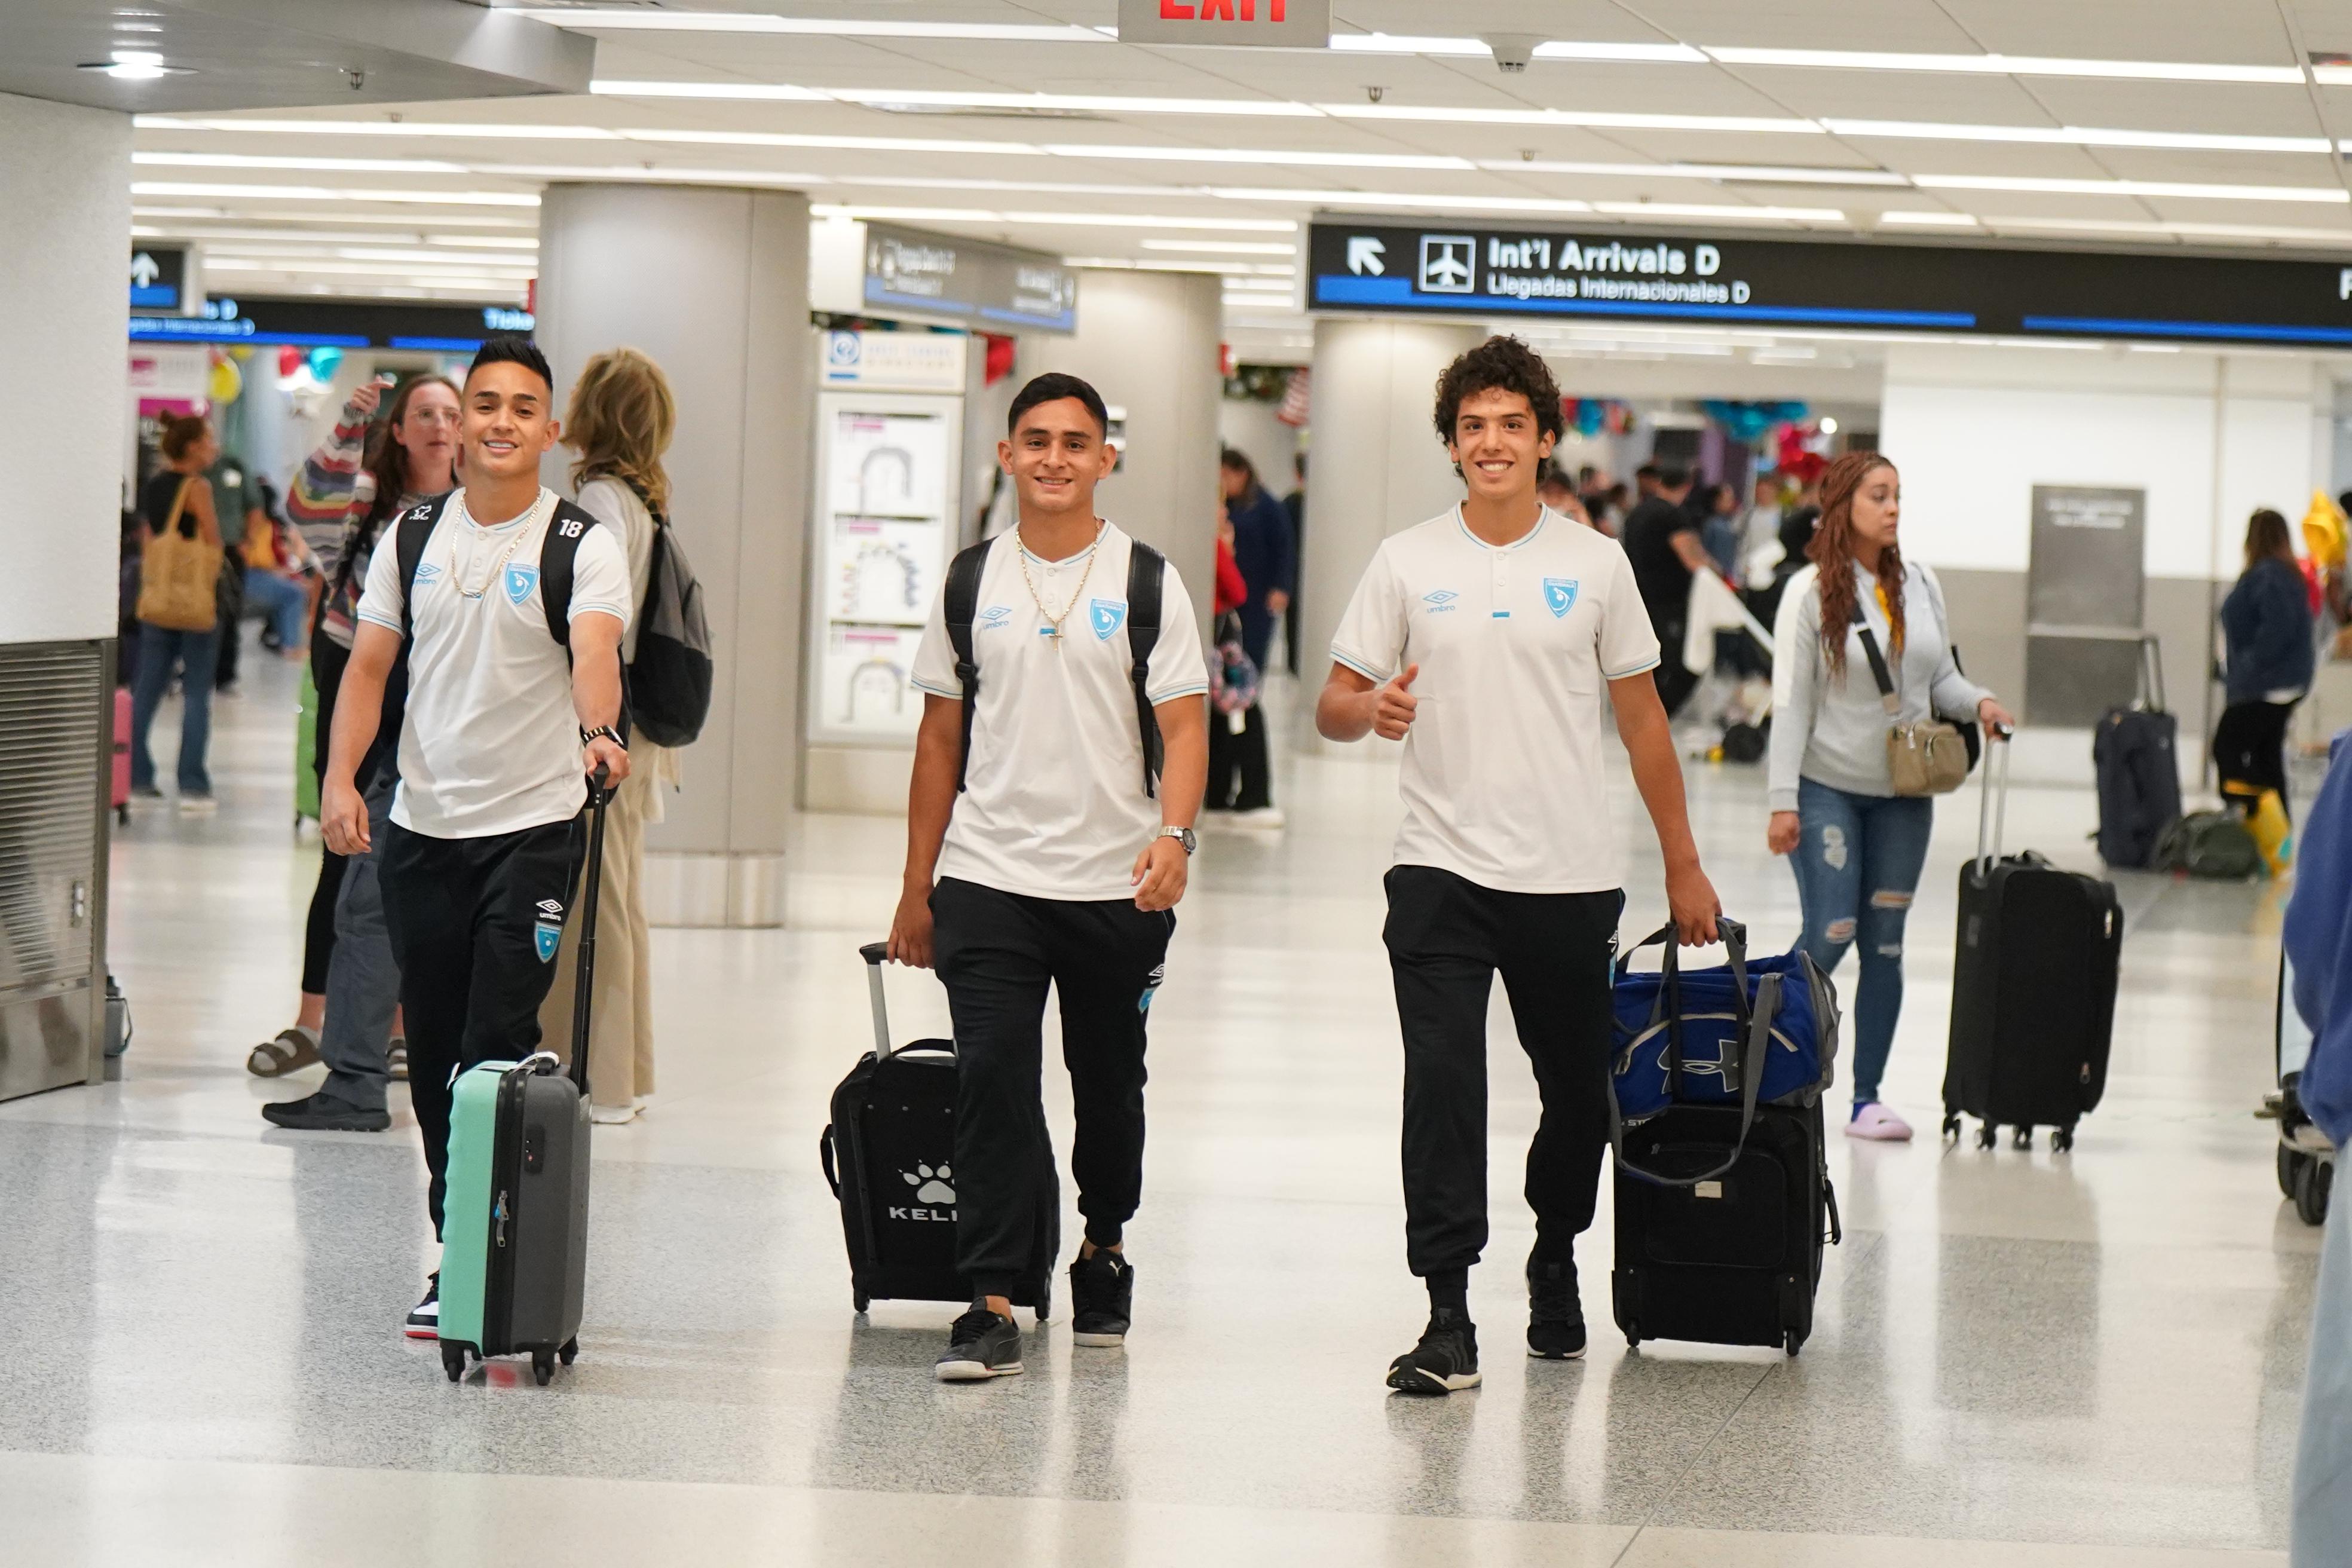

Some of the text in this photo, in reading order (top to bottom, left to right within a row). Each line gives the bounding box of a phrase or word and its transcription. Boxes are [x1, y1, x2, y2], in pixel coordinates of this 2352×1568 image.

[1488, 237, 1720, 275] Int'l Arrivals D
[1487, 272, 1750, 304] Llegadas Internacionales D
[559, 519, 583, 538] 18
[1426, 604, 1456, 614] umbro
[539, 912, 561, 921] umbro
